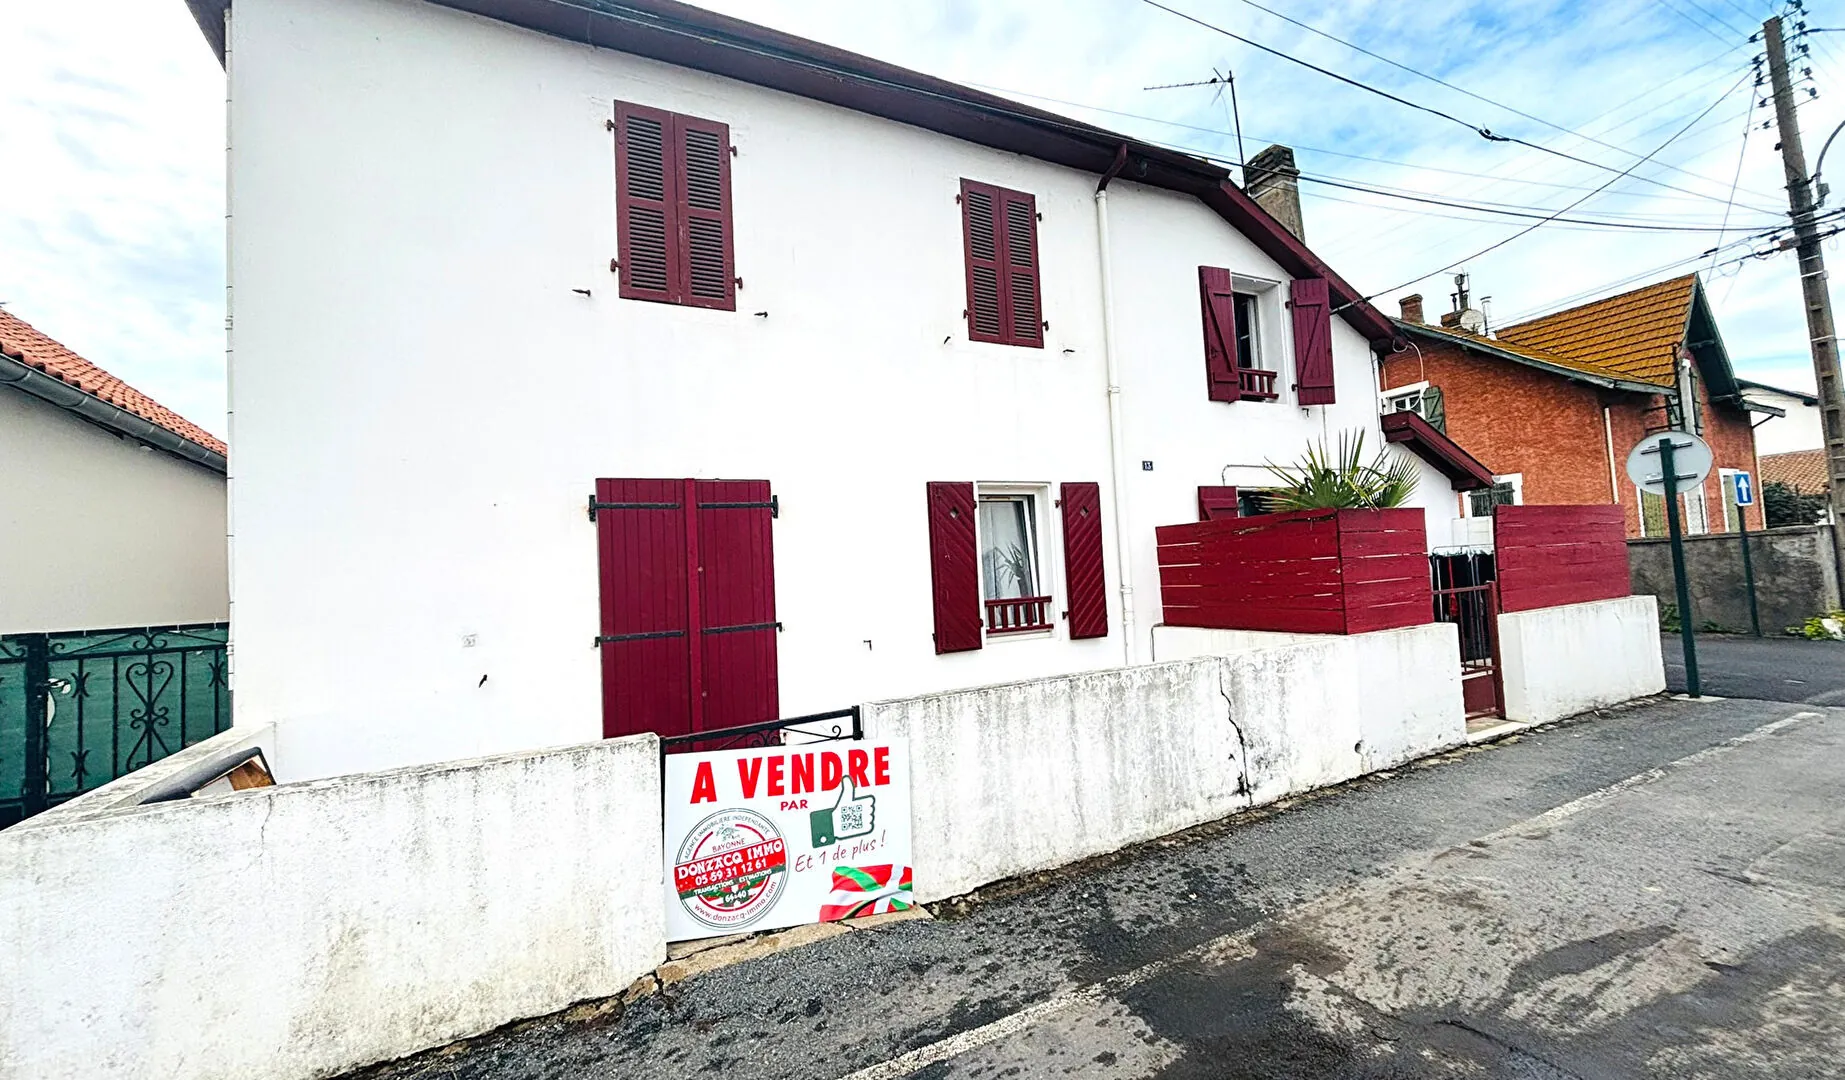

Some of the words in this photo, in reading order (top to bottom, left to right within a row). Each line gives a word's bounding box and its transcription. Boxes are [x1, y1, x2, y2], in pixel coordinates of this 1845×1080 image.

[690, 762, 717, 804] A
[738, 747, 890, 798] VENDRE
[780, 799, 808, 811] PAR
[685, 837, 699, 859] AGENCE
[712, 839, 745, 852] BAYONNE
[795, 855, 813, 872] Et
[819, 849, 826, 864] 1
[833, 845, 847, 861] de
[852, 842, 876, 860] plus
[881, 830, 887, 847] !
[678, 853, 743, 879] DONZACQ
[748, 841, 782, 860] IMMO
[696, 874, 708, 885] 05
[710, 871, 723, 882] 59
[727, 867, 737, 878] 31
[741, 863, 752, 874] 12
[756, 859, 766, 869] 61
[694, 880, 734, 894] TRANSACTIONS
[739, 869, 772, 882] ESTIMATIONS
[694, 881, 777, 922] www.donzacq-immo.com
